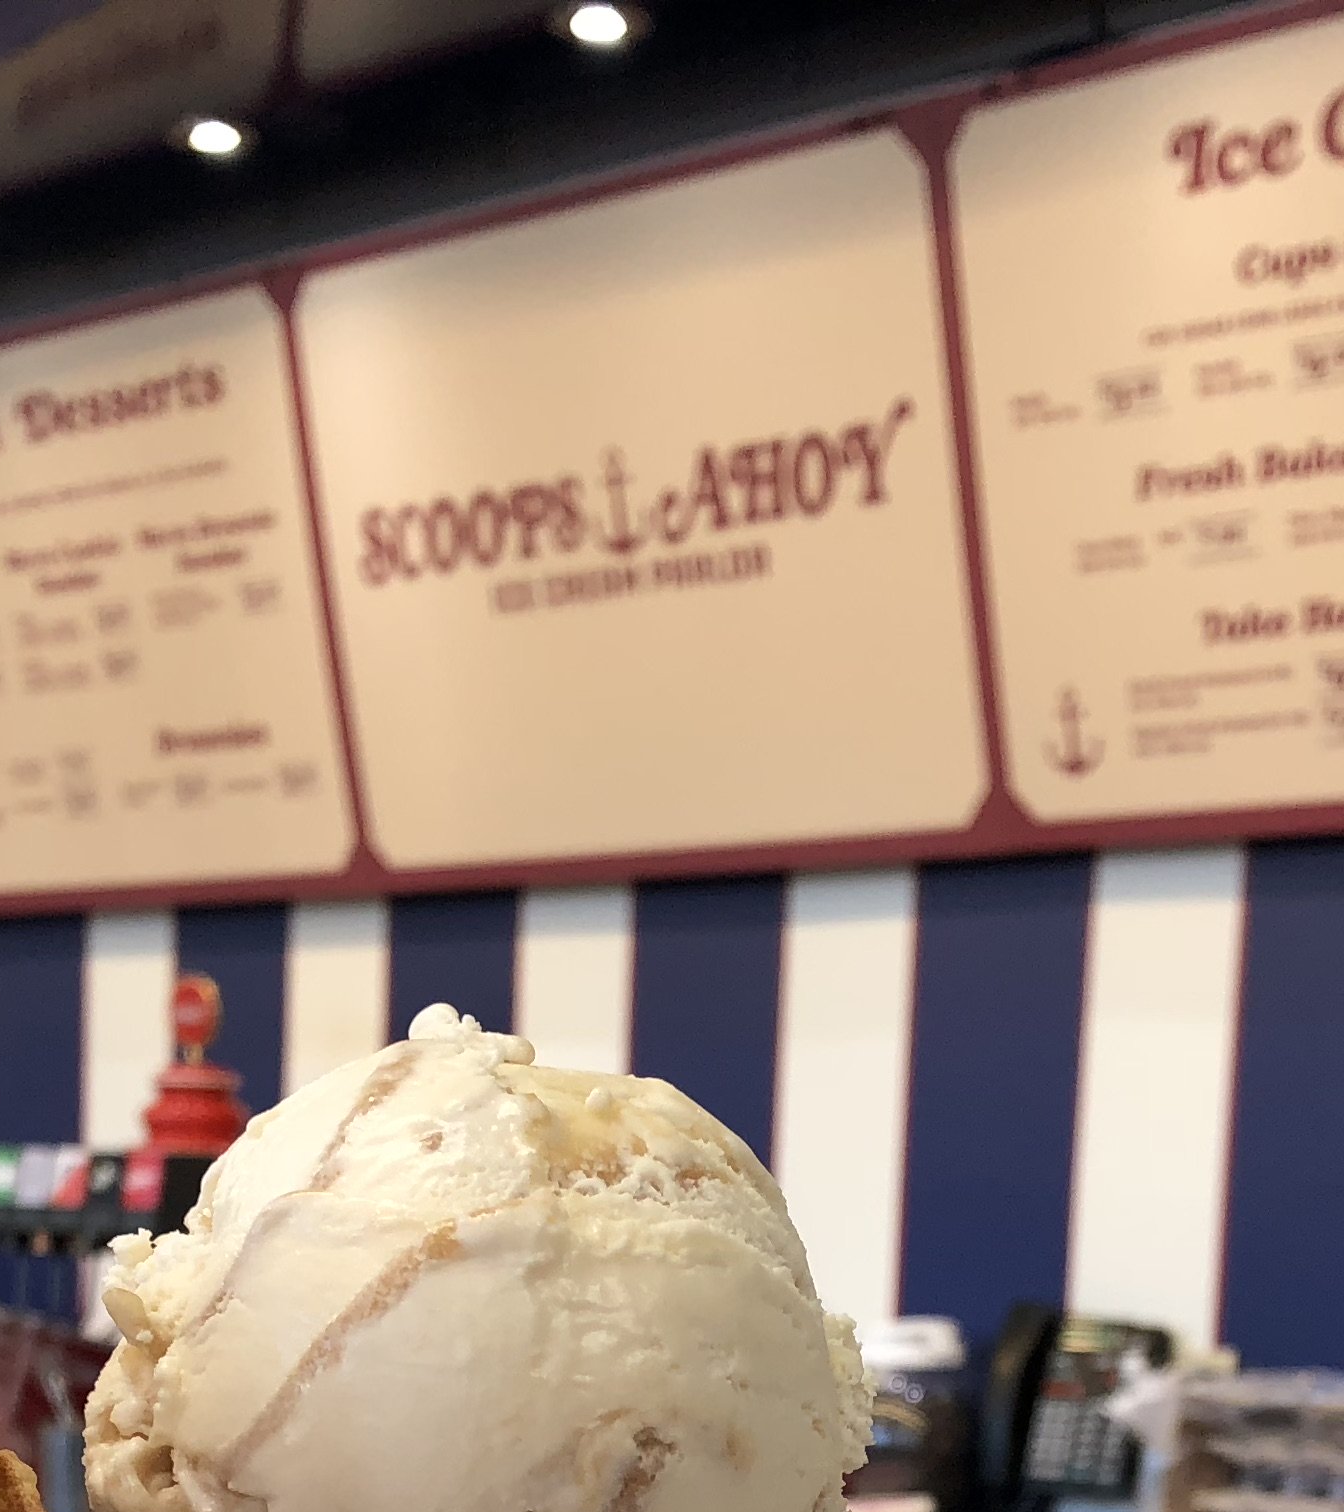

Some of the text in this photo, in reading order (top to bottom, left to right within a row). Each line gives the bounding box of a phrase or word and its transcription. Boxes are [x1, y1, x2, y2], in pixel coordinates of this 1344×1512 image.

[1167, 117, 1304, 196] Ice
[1234, 238, 1333, 288] Cups
[16, 363, 227, 443] Desserts
[358, 473, 585, 589] SCOOPS
[654, 396, 915, 545] AHOY
[1136, 453, 1244, 503] Fresh
[1199, 604, 1289, 647] Take
